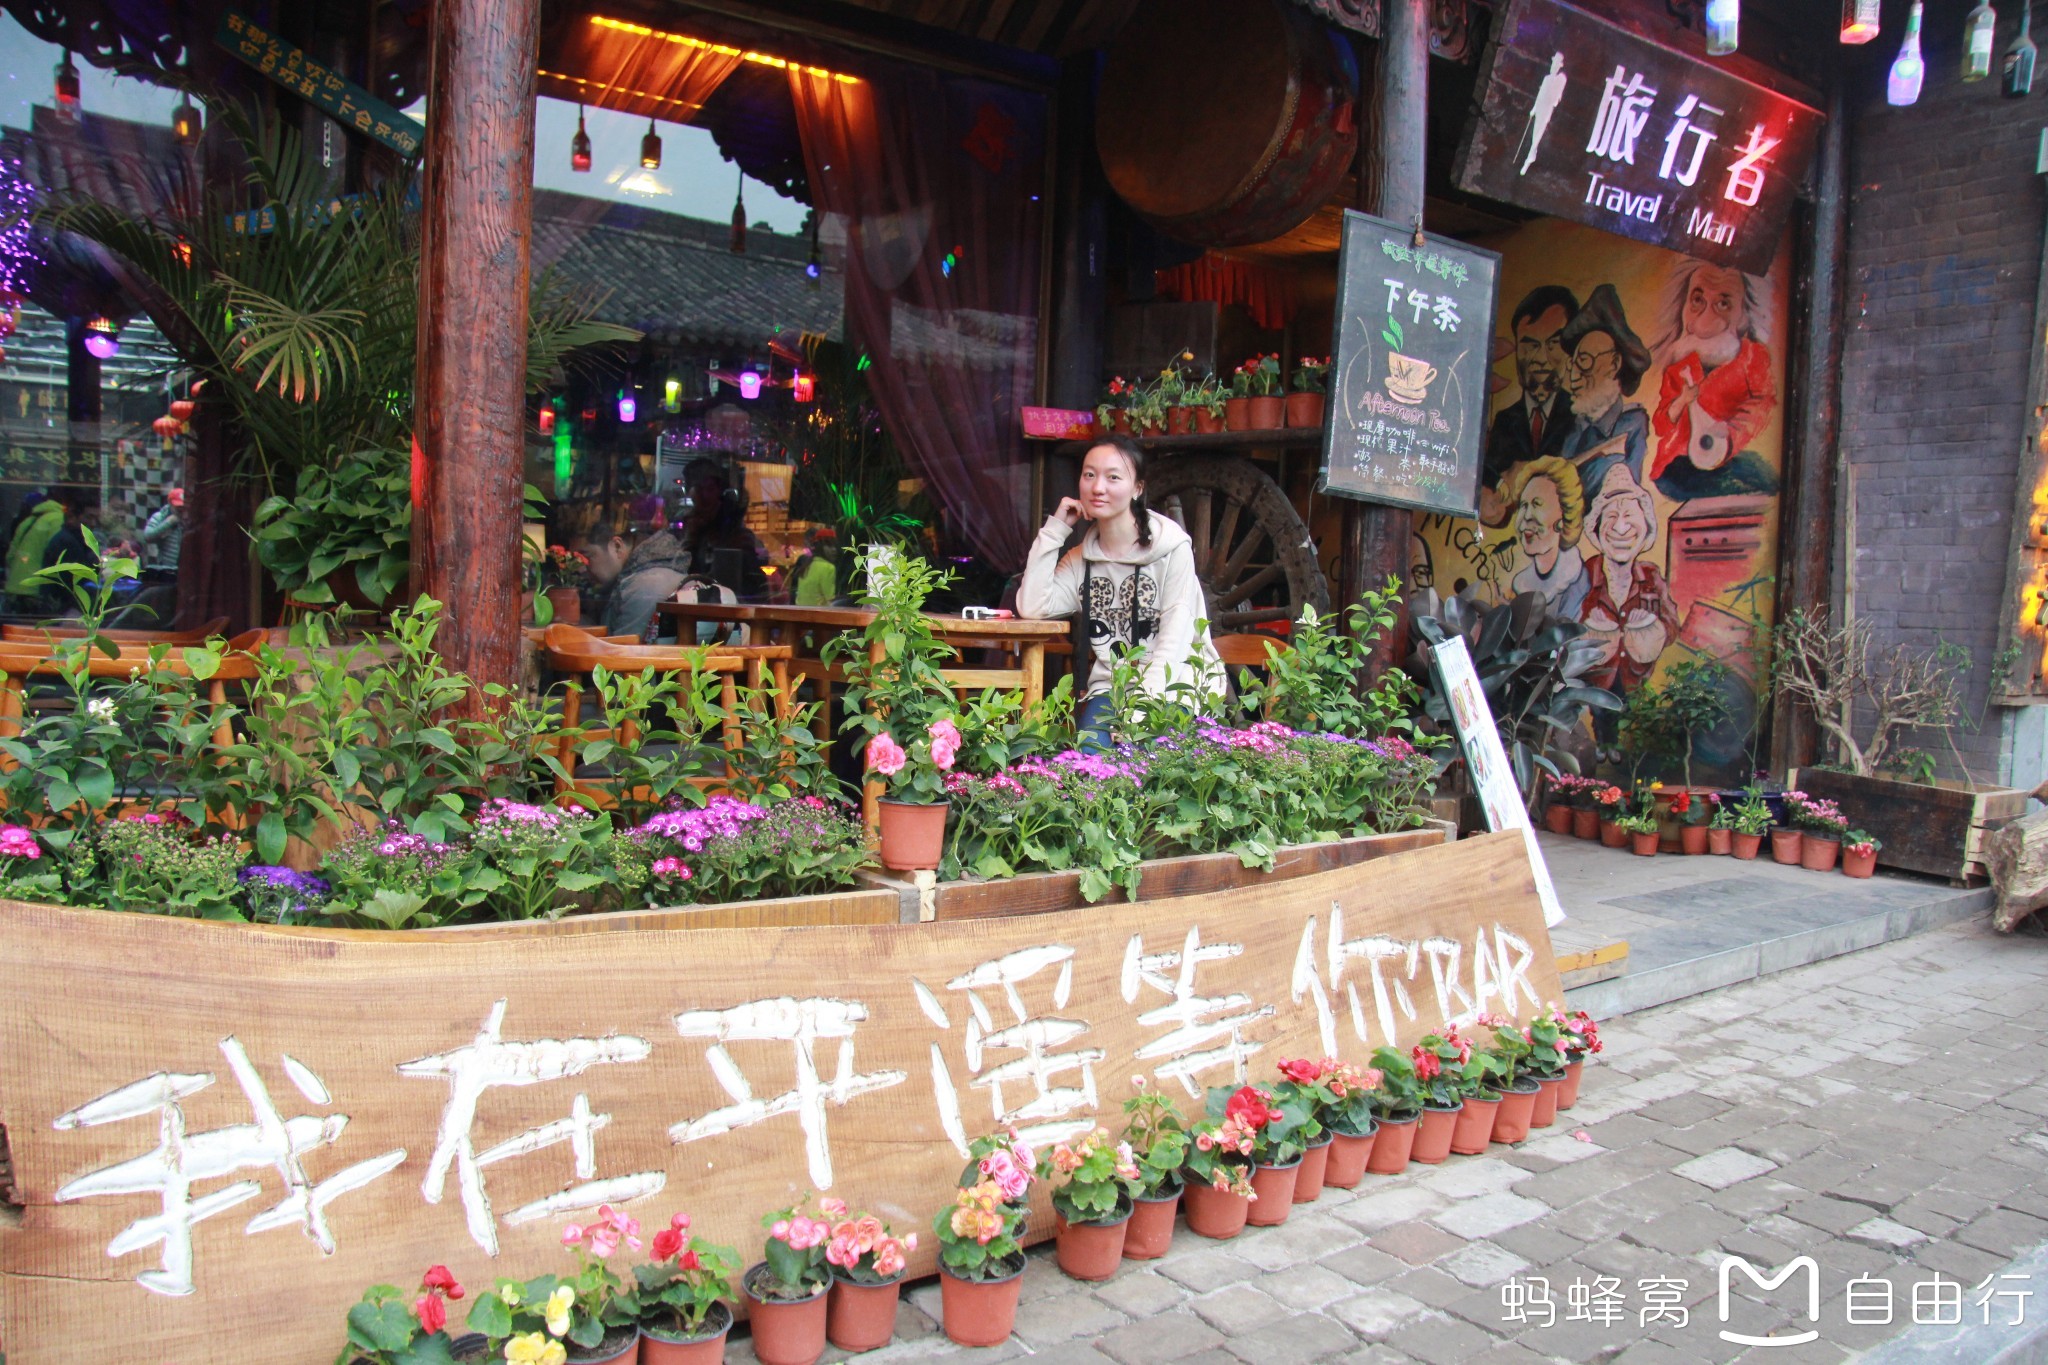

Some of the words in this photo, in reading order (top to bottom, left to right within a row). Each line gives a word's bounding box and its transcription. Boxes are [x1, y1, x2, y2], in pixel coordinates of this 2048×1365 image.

[1585, 65, 1782, 207] 旅行者
[1584, 171, 1664, 223] Travel
[1686, 207, 1736, 247] Man
[1383, 278, 1461, 332] 下午茶
[1357, 390, 1426, 426] Afternoon
